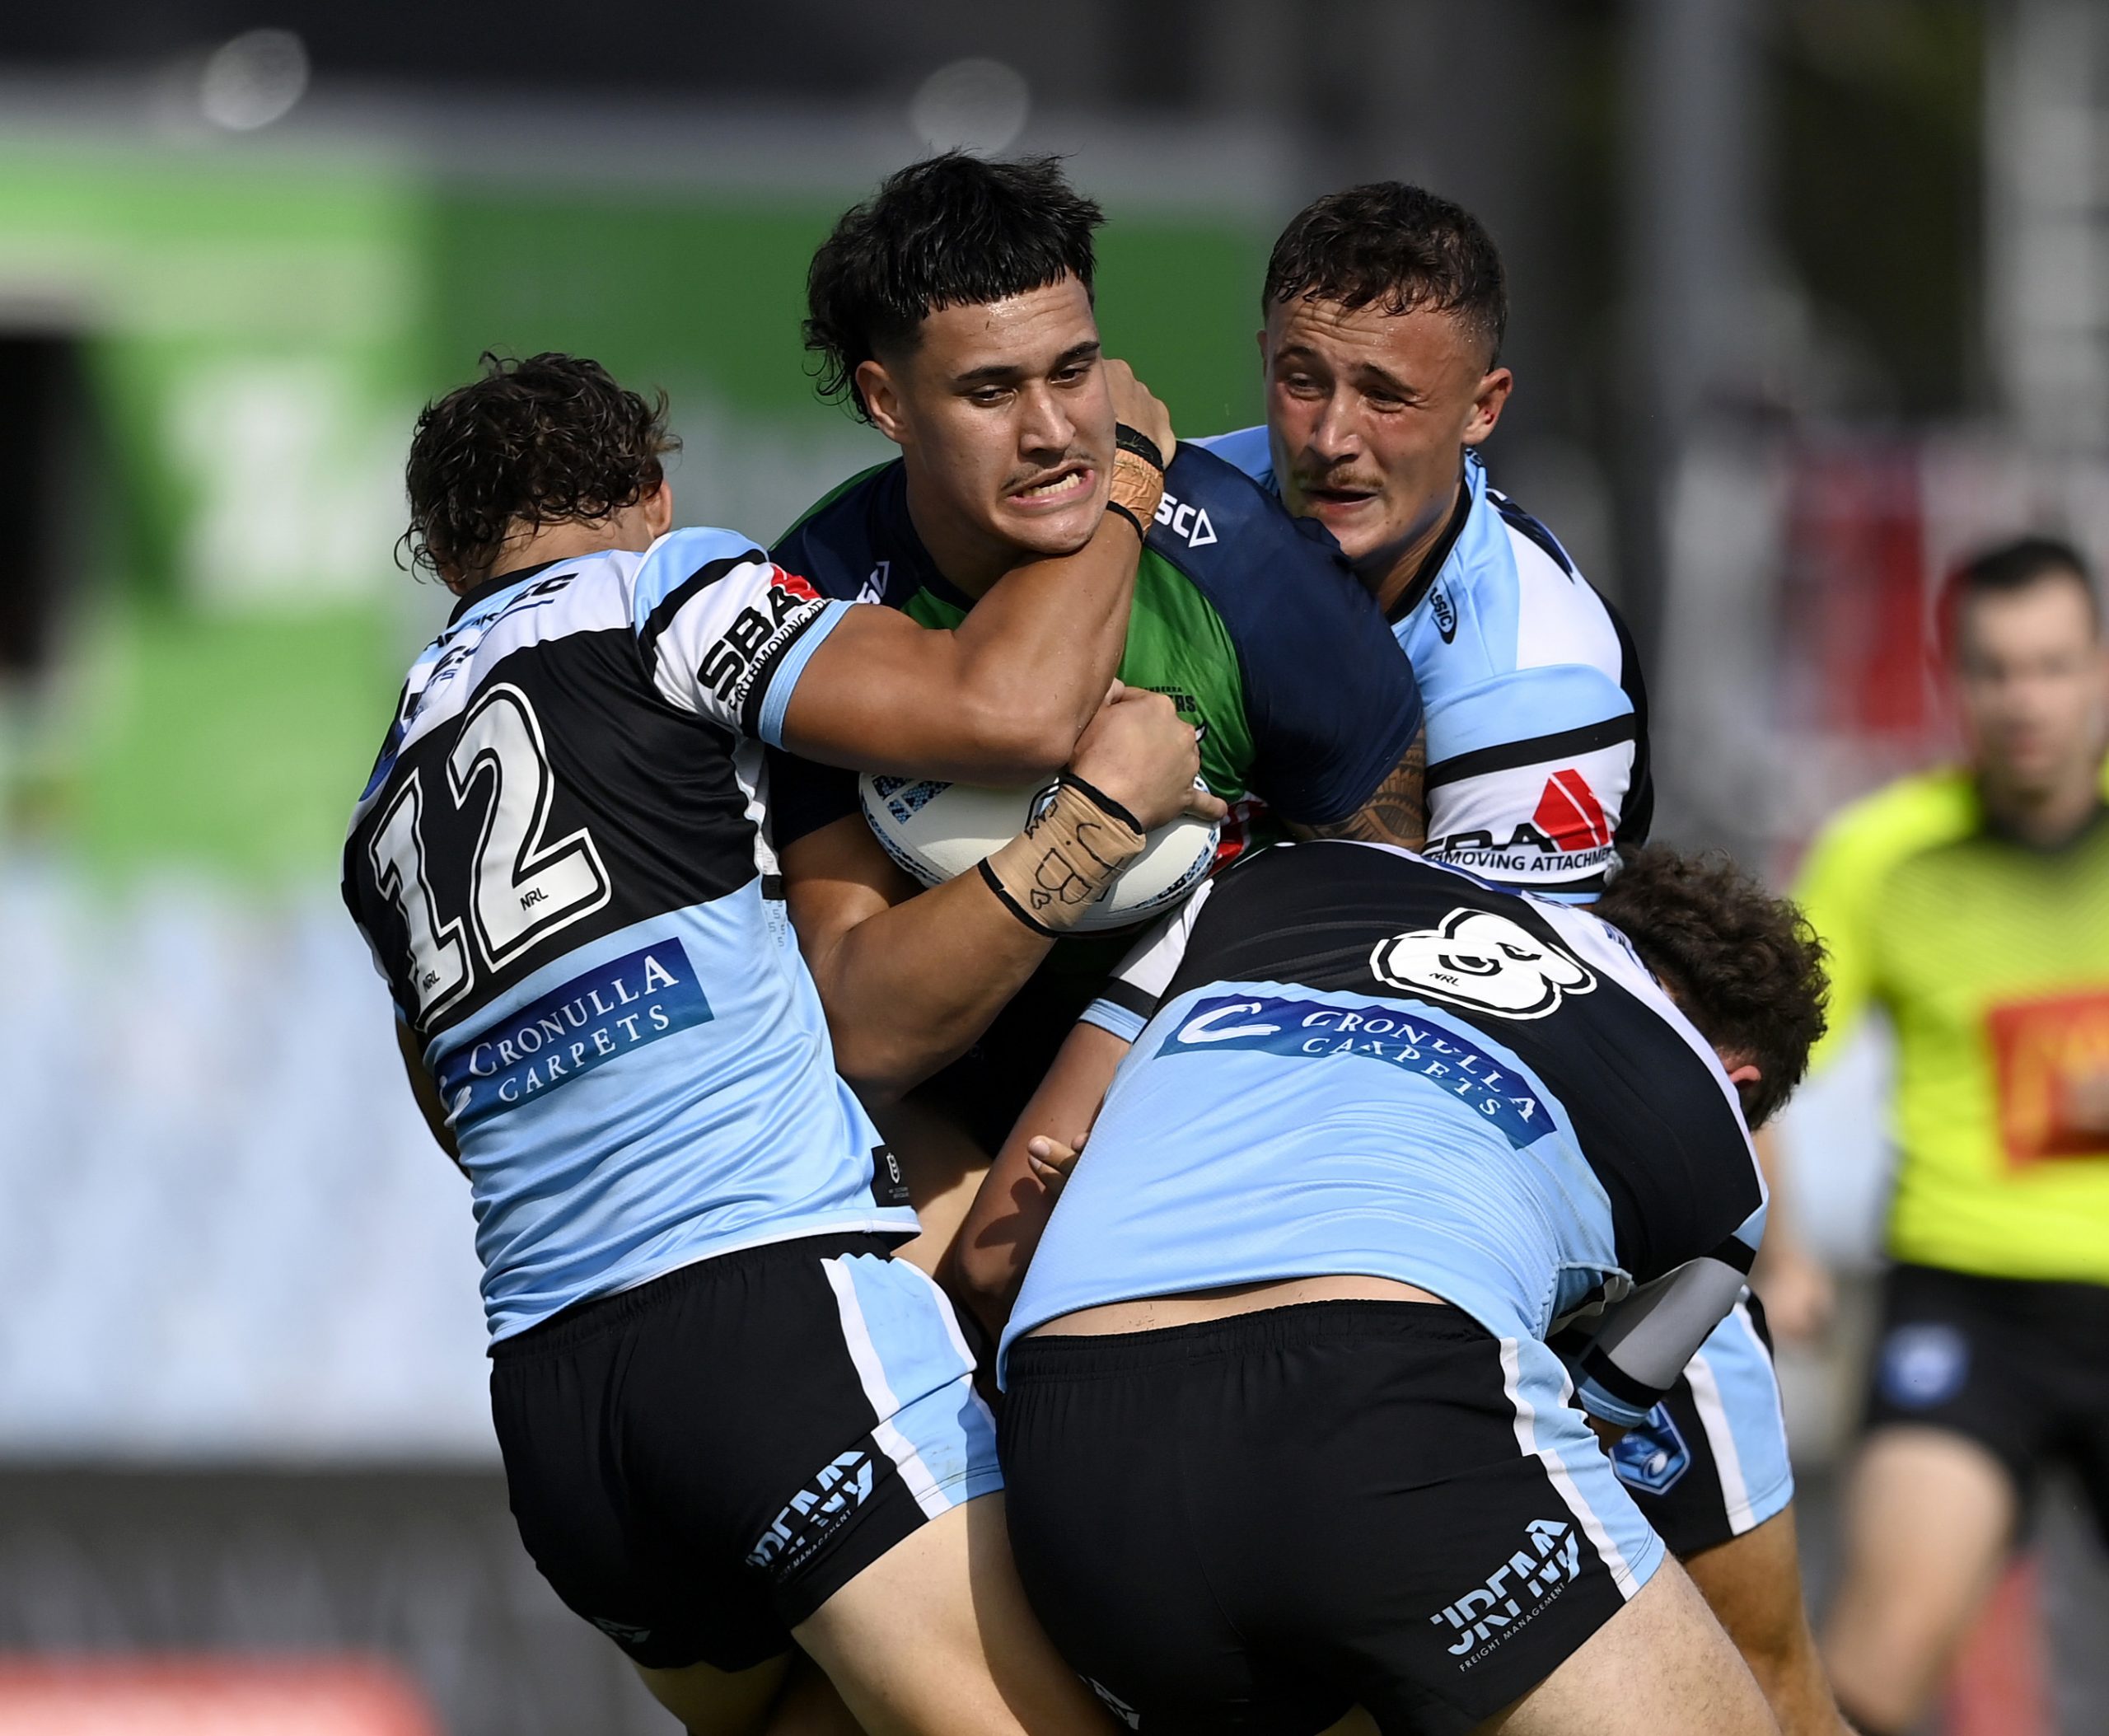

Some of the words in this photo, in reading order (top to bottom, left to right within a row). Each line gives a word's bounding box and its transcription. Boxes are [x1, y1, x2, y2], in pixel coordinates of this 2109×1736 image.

[1154, 491, 1197, 539] SC
[697, 585, 811, 702] SBA
[368, 682, 611, 1032] 12
[520, 887, 549, 910] NRL
[422, 970, 441, 993] NRL
[469, 954, 680, 1077] CRONULLA
[1429, 973, 1460, 986] NRL
[498, 1004, 670, 1102] CARPETS
[1459, 1638, 1501, 1673] FREIGHT
[1503, 1582, 1565, 1640] MANAGEMENT
